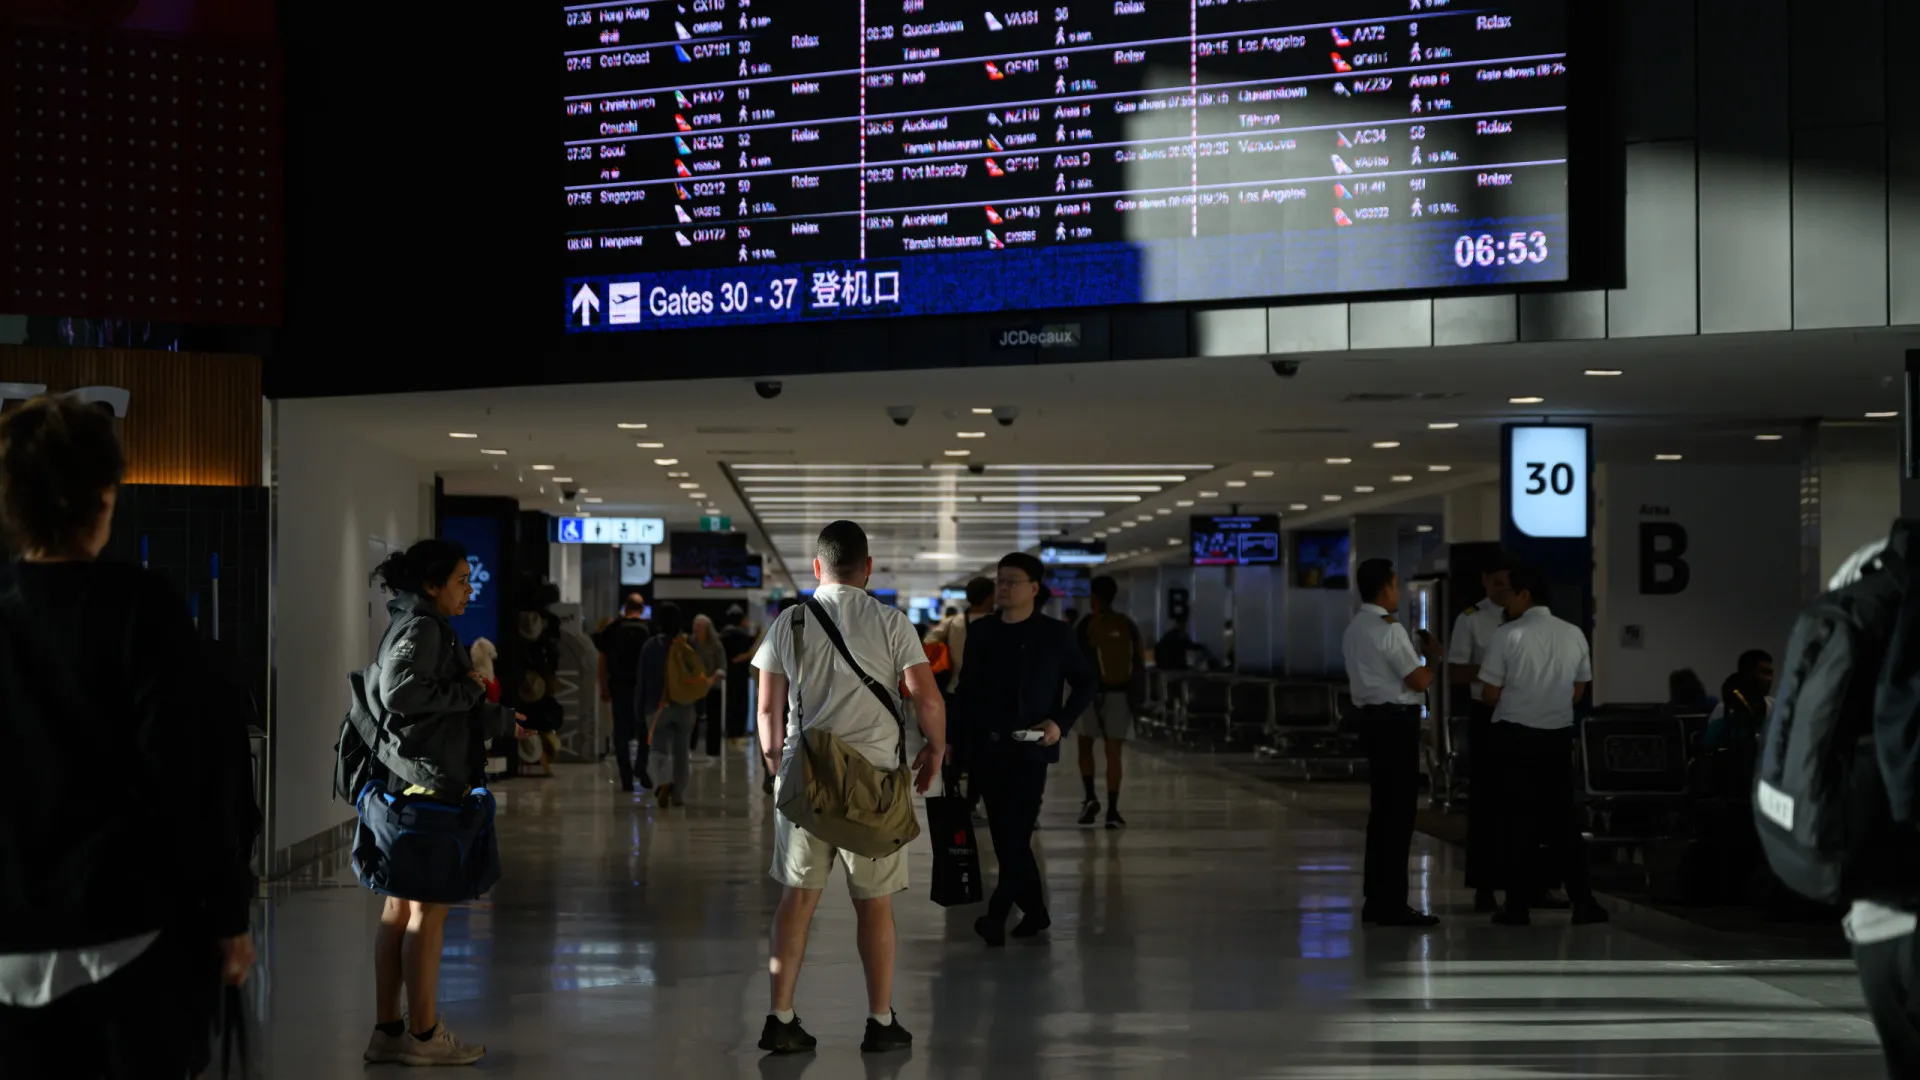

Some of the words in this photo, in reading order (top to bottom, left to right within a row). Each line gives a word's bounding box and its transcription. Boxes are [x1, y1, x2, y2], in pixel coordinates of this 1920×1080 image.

[1476, 15, 1512, 30] Relax
[792, 34, 820, 48] Relax
[1238, 39, 1258, 53] Los
[1260, 34, 1306, 52] Angeles
[600, 54, 622, 68] Gold
[622, 51, 650, 64] Coast
[1114, 50, 1146, 64] Relax
[792, 82, 820, 96] Relax
[902, 116, 948, 132] Auckland
[792, 128, 820, 142] Relax
[902, 167, 924, 180] Port
[1478, 173, 1512, 186] Relax
[694, 182, 726, 196] SQ212
[792, 175, 820, 188] Relax
[600, 190, 646, 204] Singapore
[902, 212, 948, 227] Auckland
[792, 222, 820, 236] Relax
[600, 236, 643, 249] Denpasar
[1455, 230, 1548, 268] 06:53
[812, 268, 901, 309] 登机口
[649, 286, 714, 316] Gates
[720, 281, 748, 312] 30
[770, 278, 799, 310] 37
[999, 330, 1072, 346] JCDecaux
[1526, 462, 1575, 495] 30
[1638, 504, 1670, 516] Area
[626, 552, 646, 567] 31
[1639, 522, 1690, 595] B
[1170, 588, 1189, 618] B
